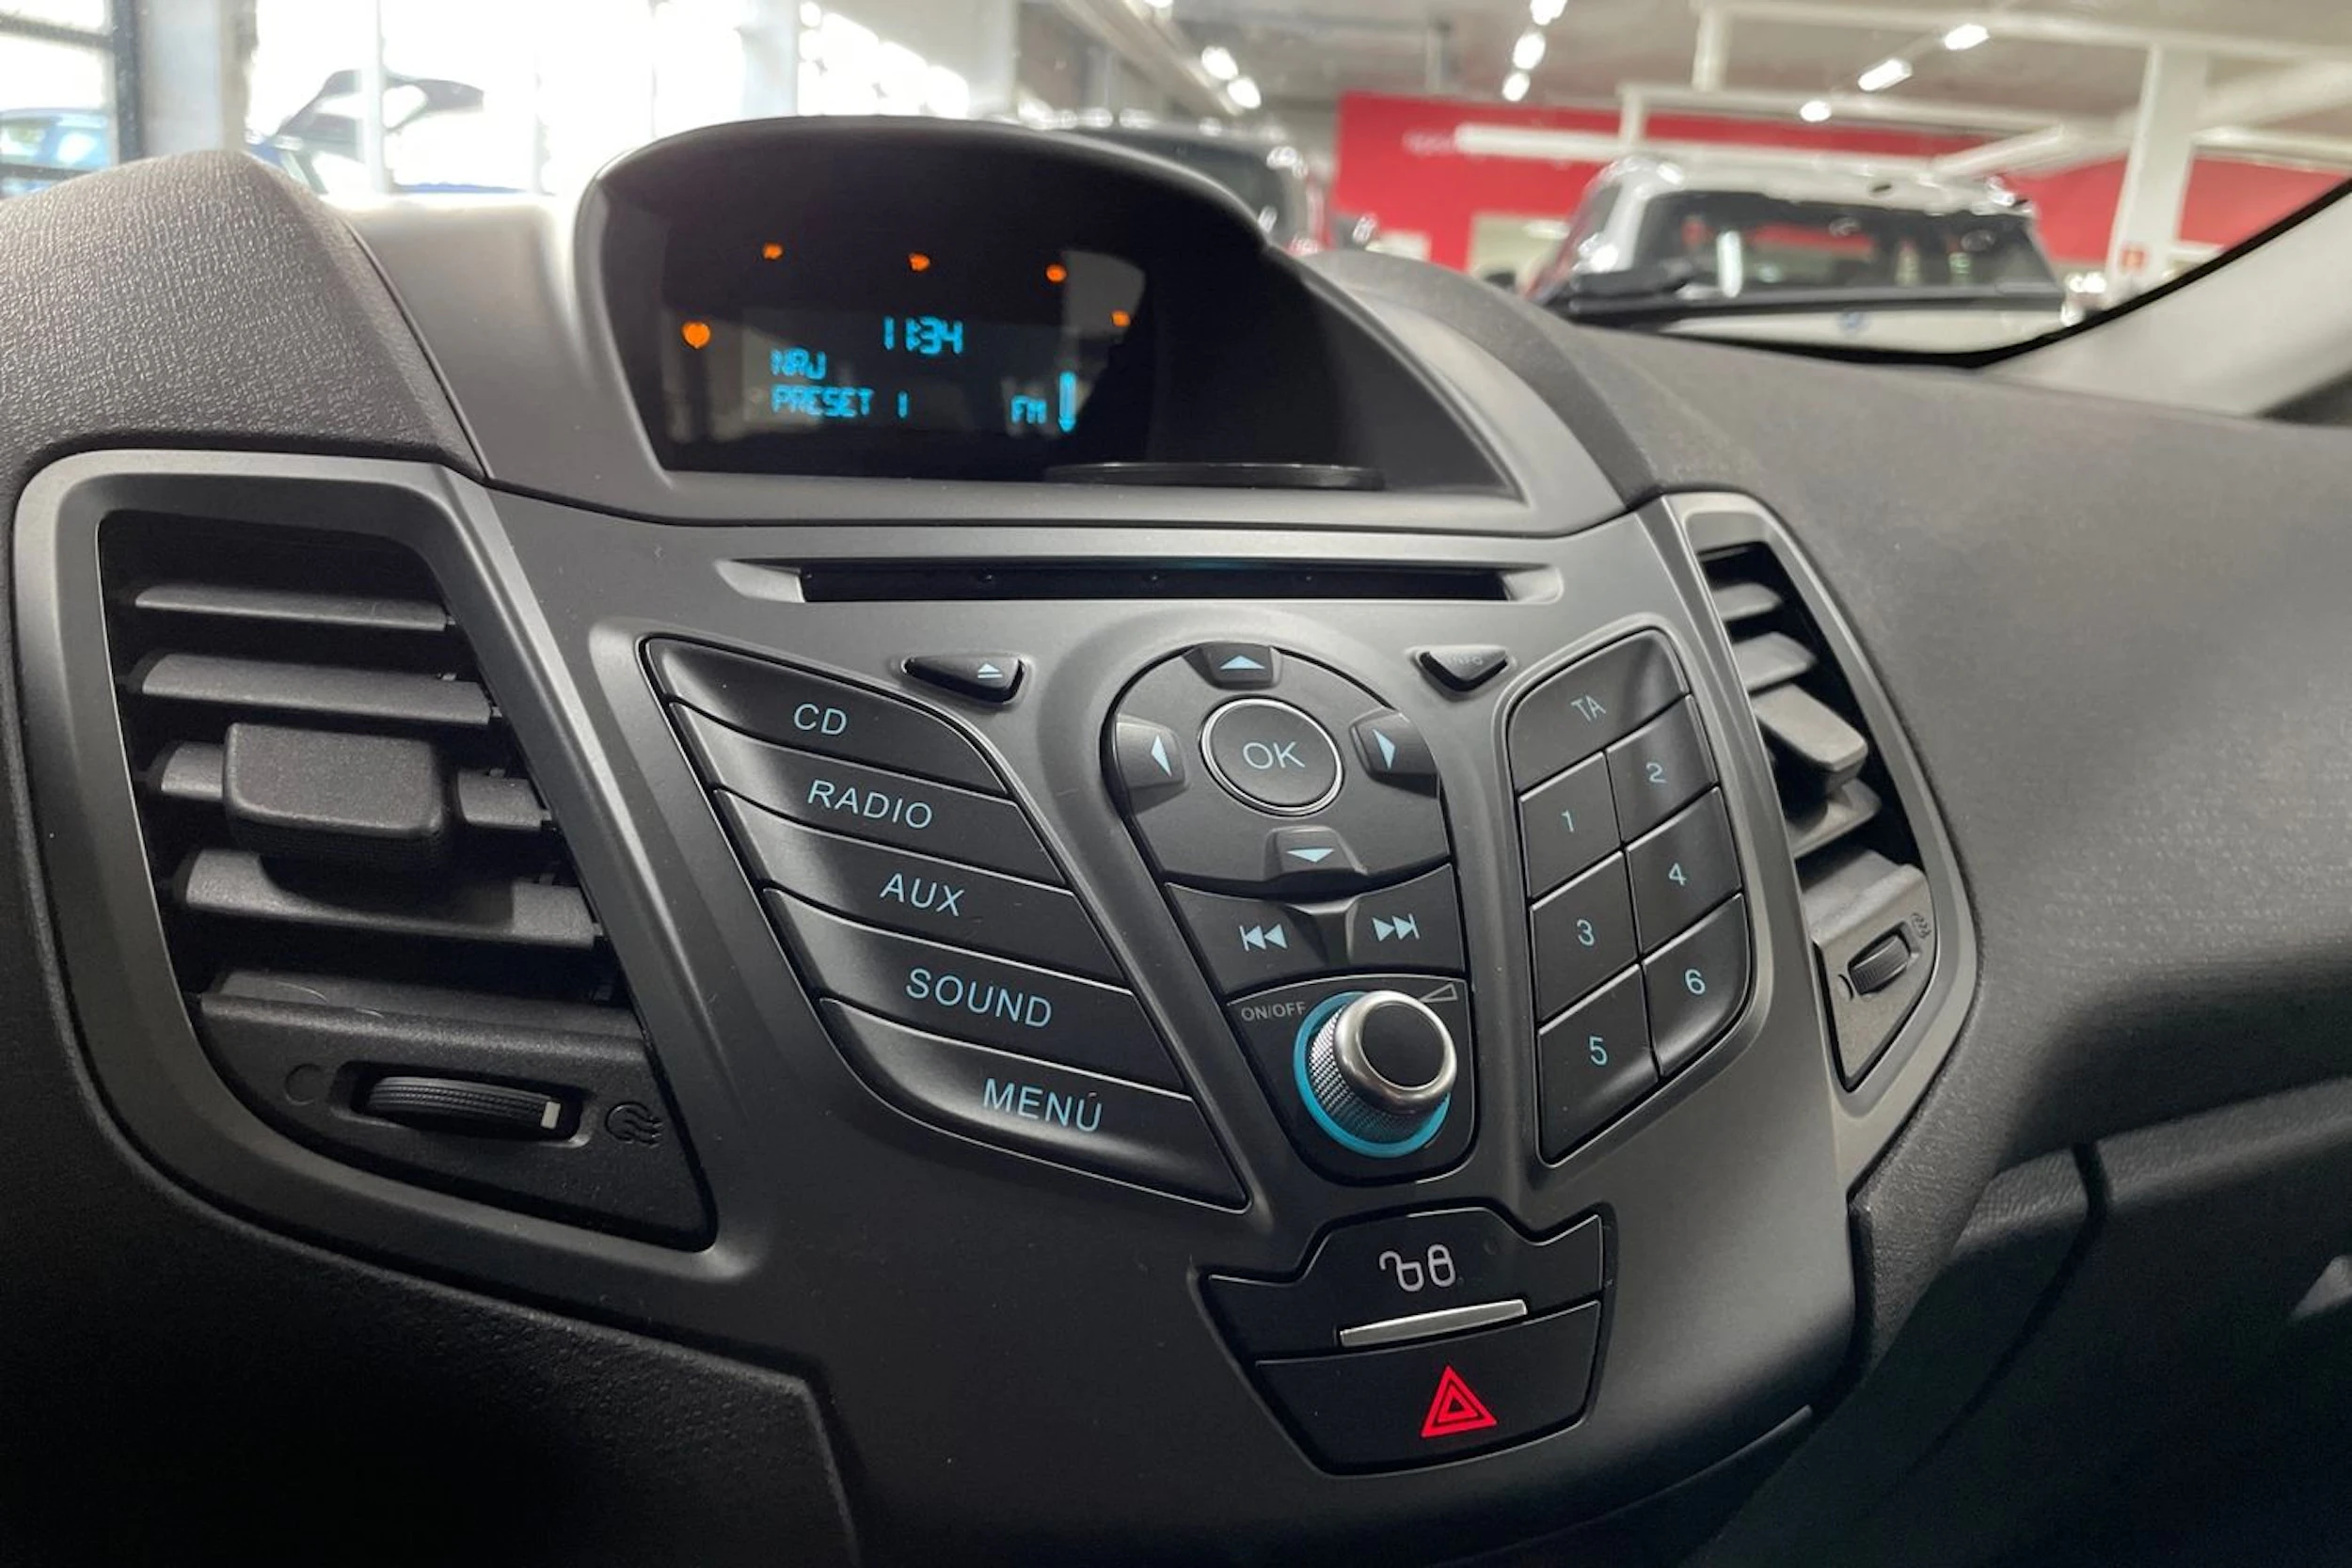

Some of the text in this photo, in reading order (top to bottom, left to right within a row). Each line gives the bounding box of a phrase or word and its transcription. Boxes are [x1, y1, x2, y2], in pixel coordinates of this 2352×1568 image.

[771, 383, 874, 418] PRESET
[1009, 395, 1047, 425] FM
[794, 703, 848, 736] CD
[1570, 695, 1607, 722] TA
[1242, 741, 1306, 769] OK
[1645, 761, 1668, 784] 2
[807, 779, 932, 829] RADIO
[1561, 810, 1574, 833] 1
[1668, 863, 1687, 886] 4
[880, 872, 965, 917] AUX
[1577, 919, 1595, 946] 3
[1684, 969, 1706, 994] 6
[905, 968, 1052, 1027] SOUND
[1241, 1001, 1307, 1022] ON/OFF
[1589, 1037, 1608, 1066] 5
